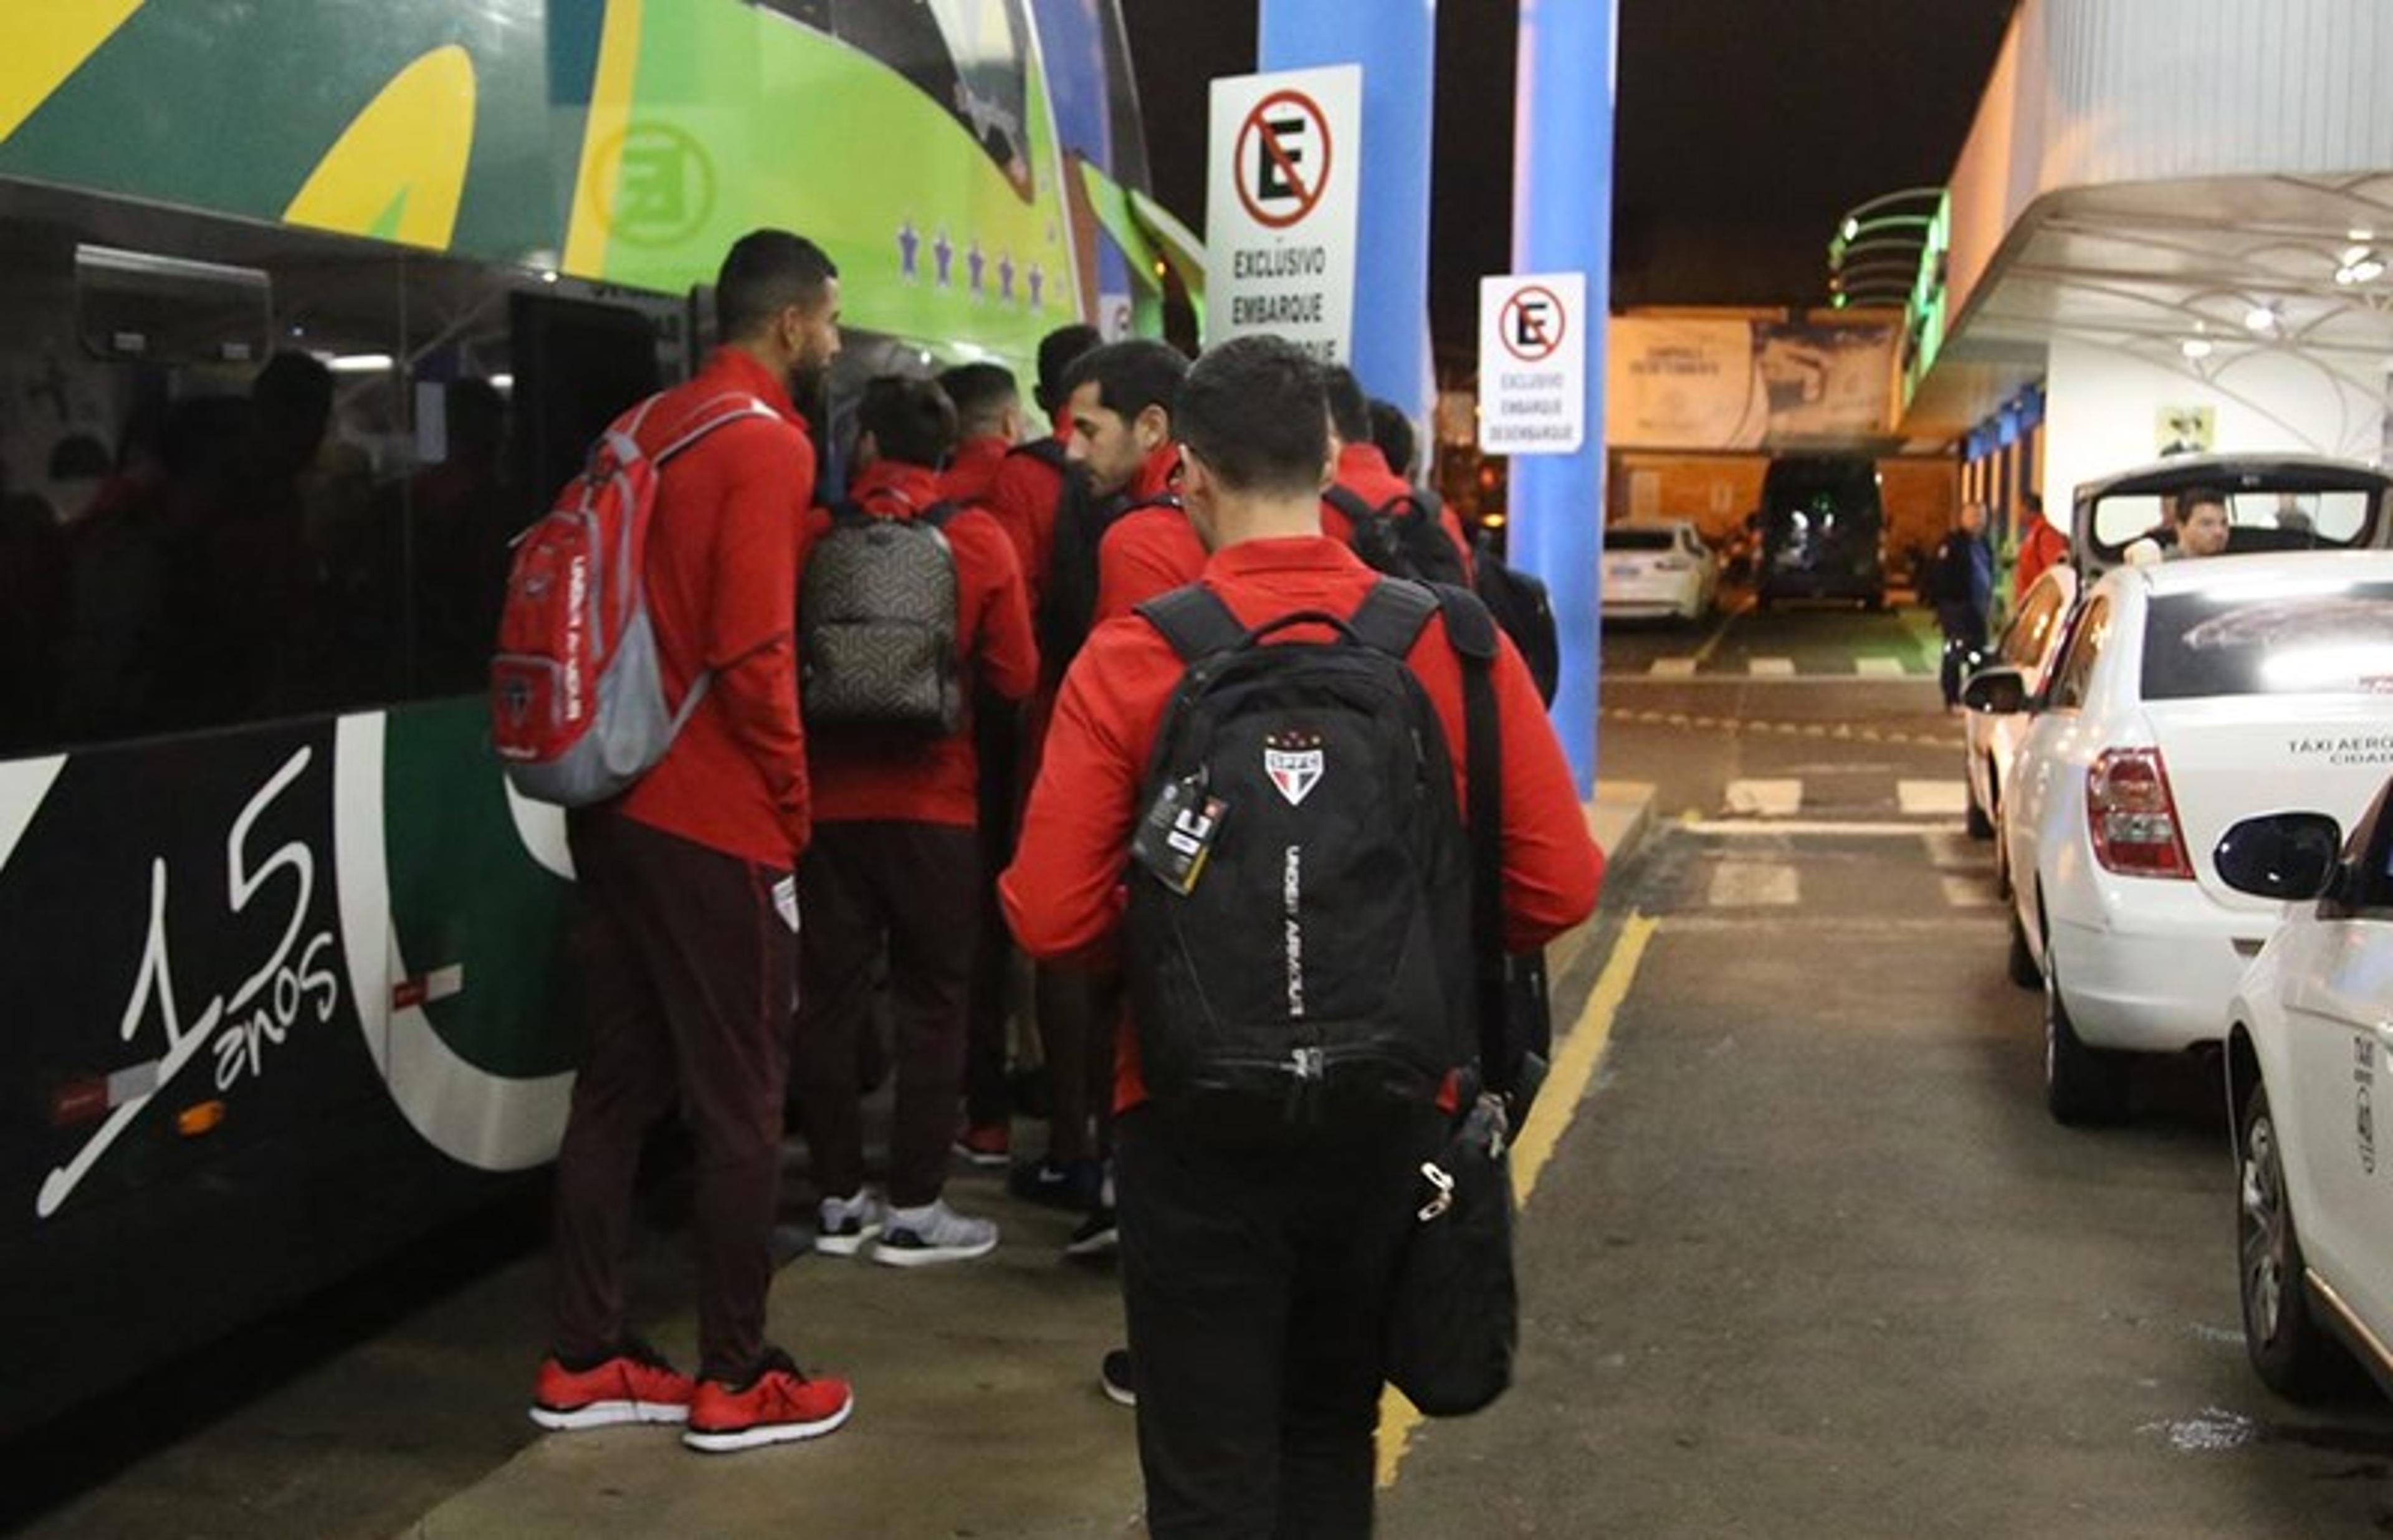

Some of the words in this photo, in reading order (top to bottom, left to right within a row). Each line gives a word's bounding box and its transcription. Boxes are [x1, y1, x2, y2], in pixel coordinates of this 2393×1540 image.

[1234, 246, 1326, 278] EXCLUSIVO
[1232, 293, 1323, 325] EMBARQUE
[212, 931, 338, 1091] anos
